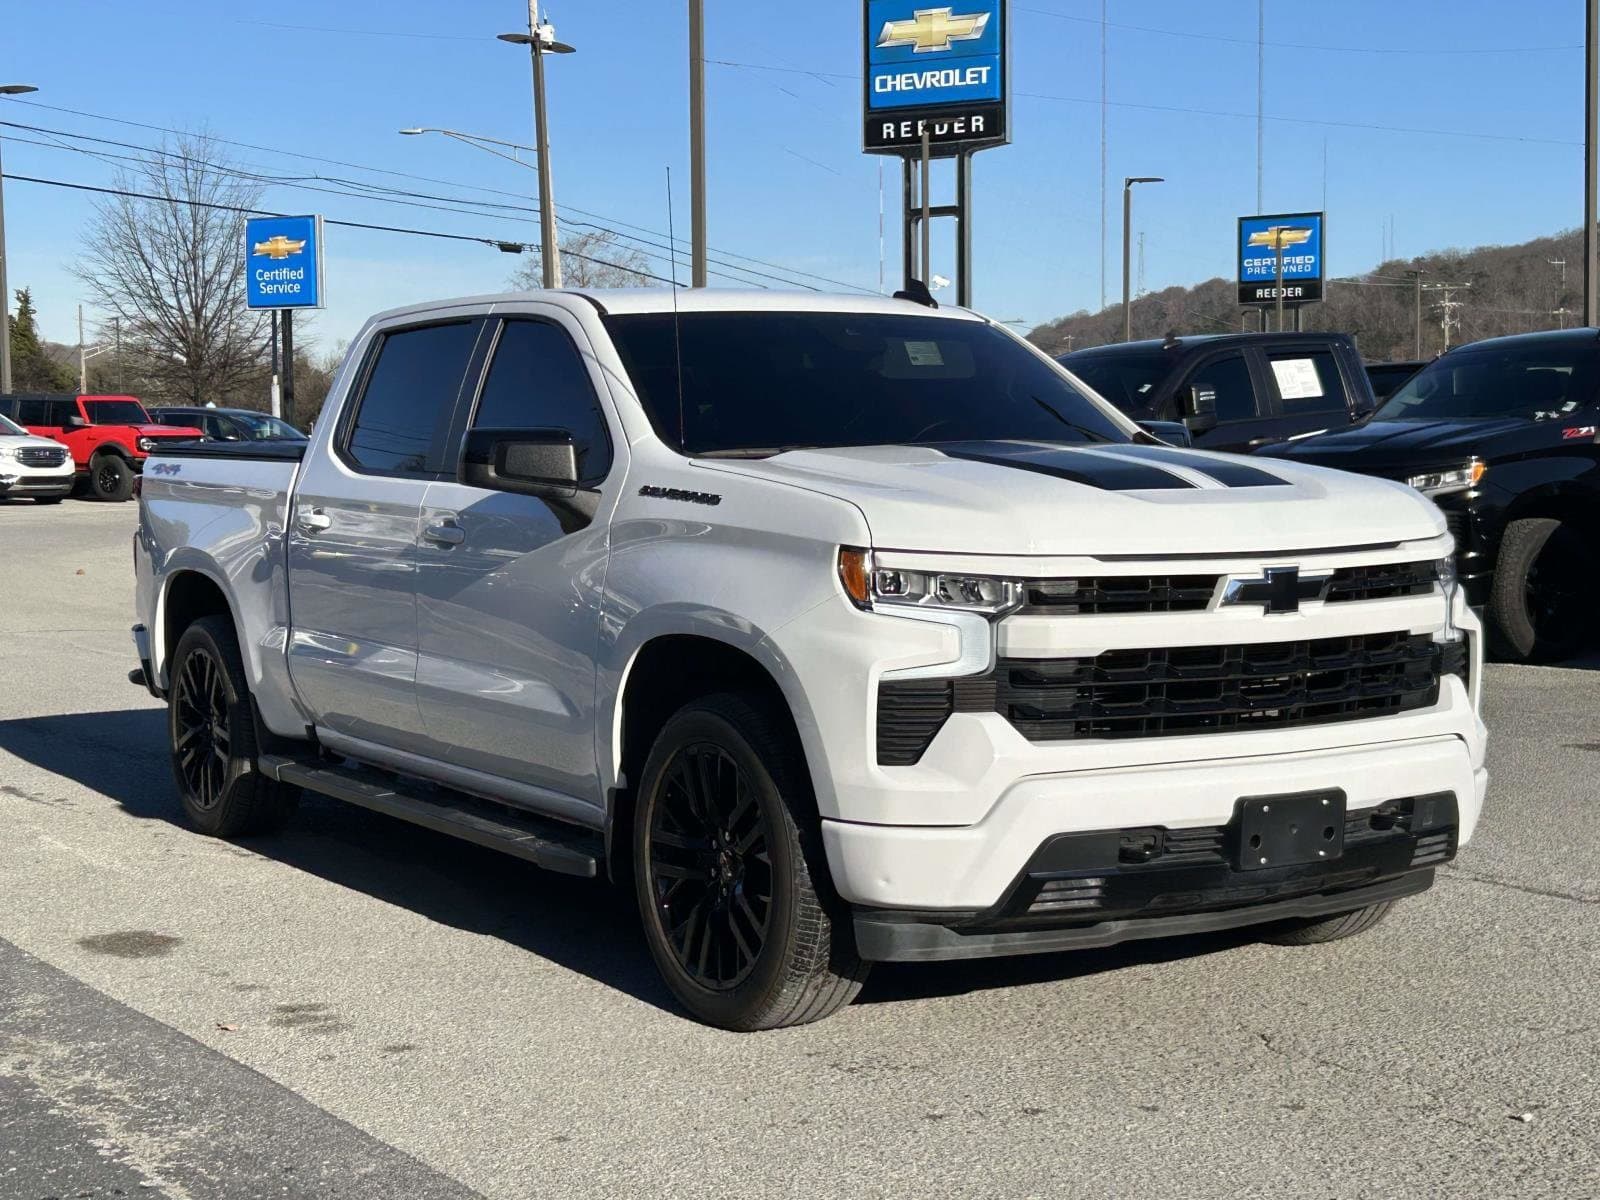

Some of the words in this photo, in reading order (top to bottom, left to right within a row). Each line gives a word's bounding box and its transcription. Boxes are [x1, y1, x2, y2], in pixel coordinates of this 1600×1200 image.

[875, 66, 991, 93] CHEVROLET
[255, 267, 304, 281] Certified
[259, 282, 301, 294] Service
